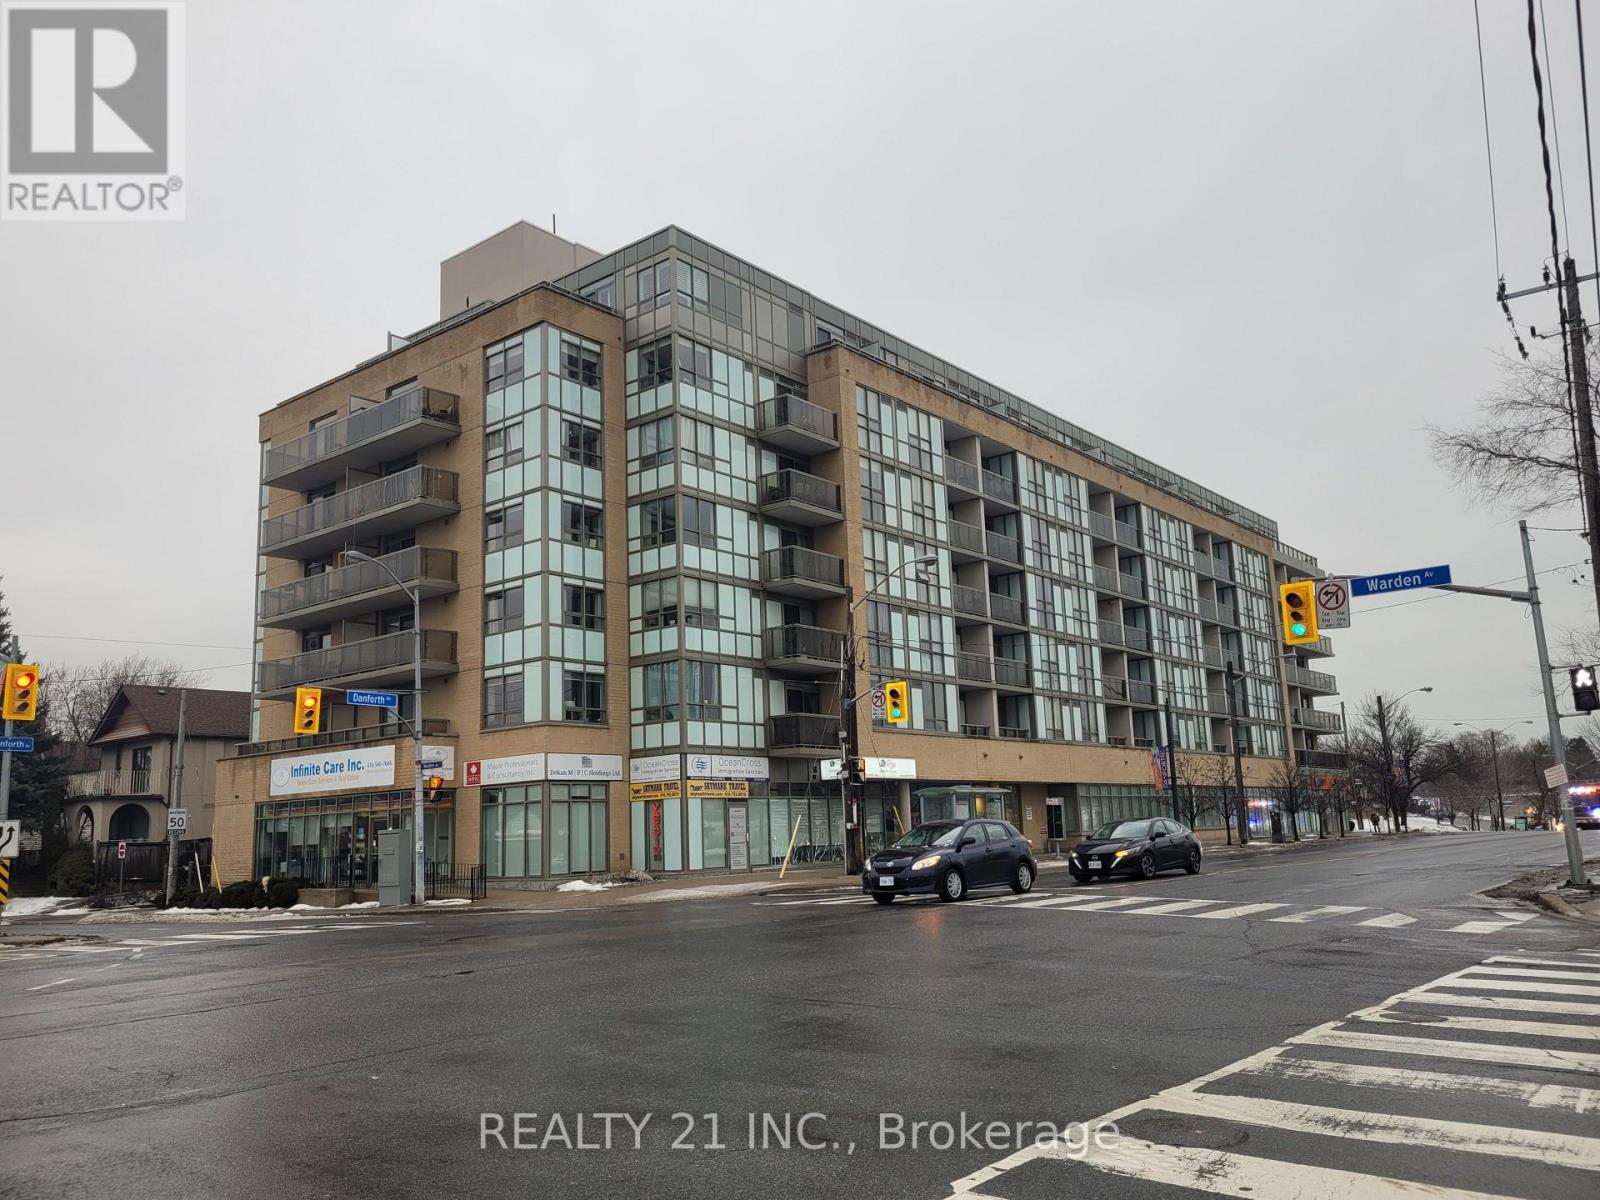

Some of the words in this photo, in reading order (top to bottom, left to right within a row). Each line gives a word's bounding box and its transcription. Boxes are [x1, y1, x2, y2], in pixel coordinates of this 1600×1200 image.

[1366, 575, 1422, 592] Warden
[353, 693, 385, 704] Danforth
[719, 757, 762, 767] OceanCross
[290, 763, 321, 778] Infinite
[323, 761, 345, 775] Care
[347, 758, 365, 772] Inc.
[589, 769, 611, 777] Holdings
[704, 782, 727, 791] SKYMARK
[729, 782, 747, 791] TRAVEL
[170, 817, 184, 827] 50
